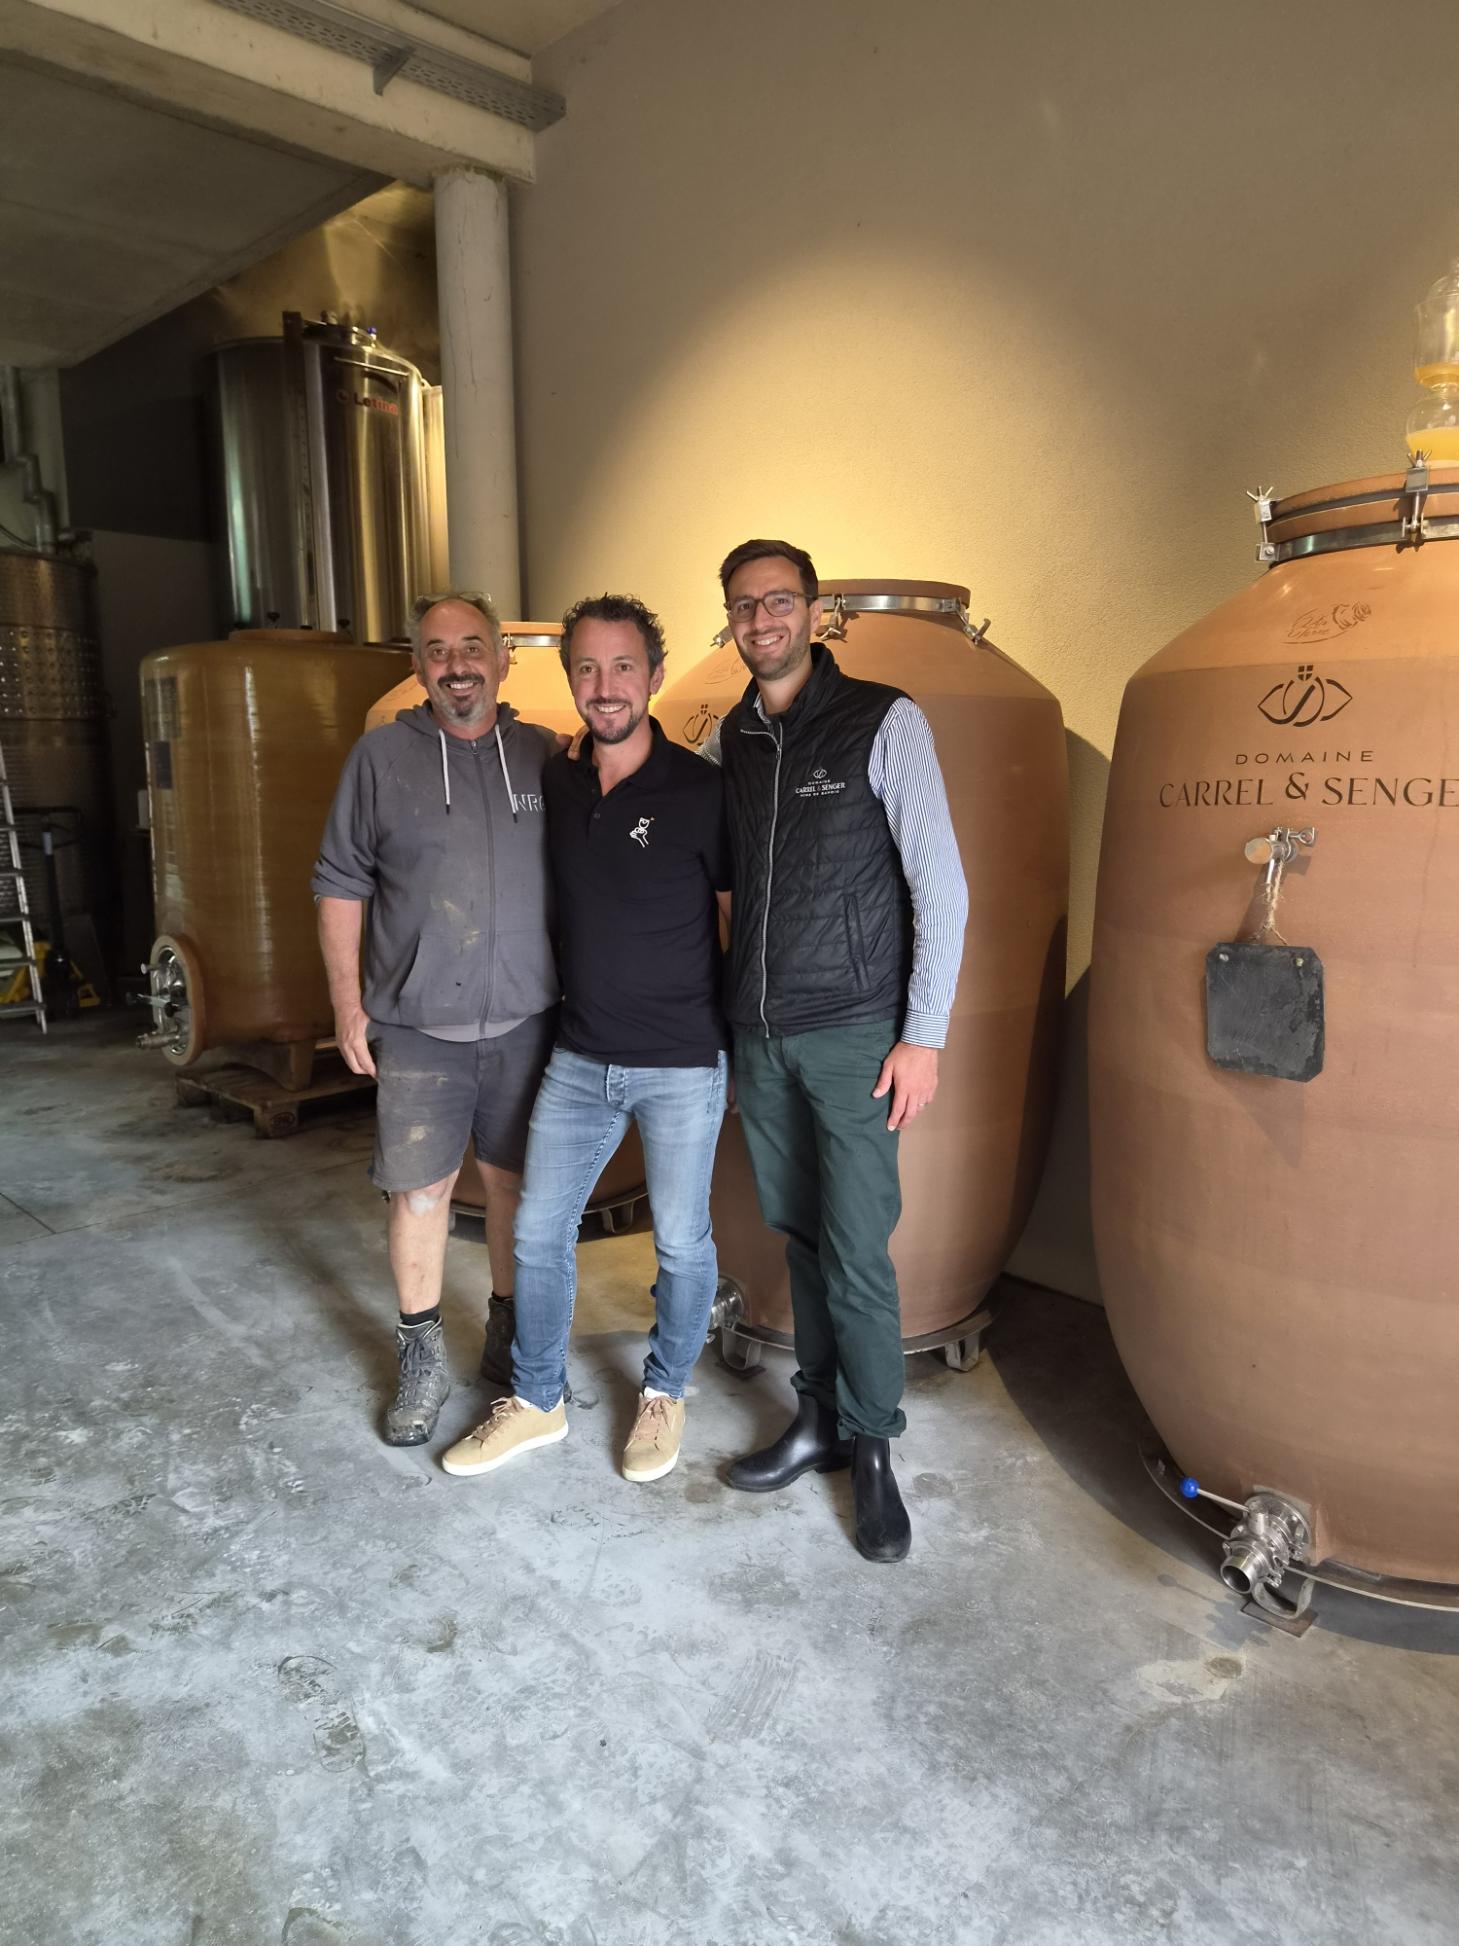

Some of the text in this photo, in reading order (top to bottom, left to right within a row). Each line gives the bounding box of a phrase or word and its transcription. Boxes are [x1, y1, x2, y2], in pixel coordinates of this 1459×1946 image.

[1235, 750, 1374, 765] DOMAINE
[822, 782, 846, 791] SENGER
[1159, 771, 1459, 808] CARREL & SENGE
